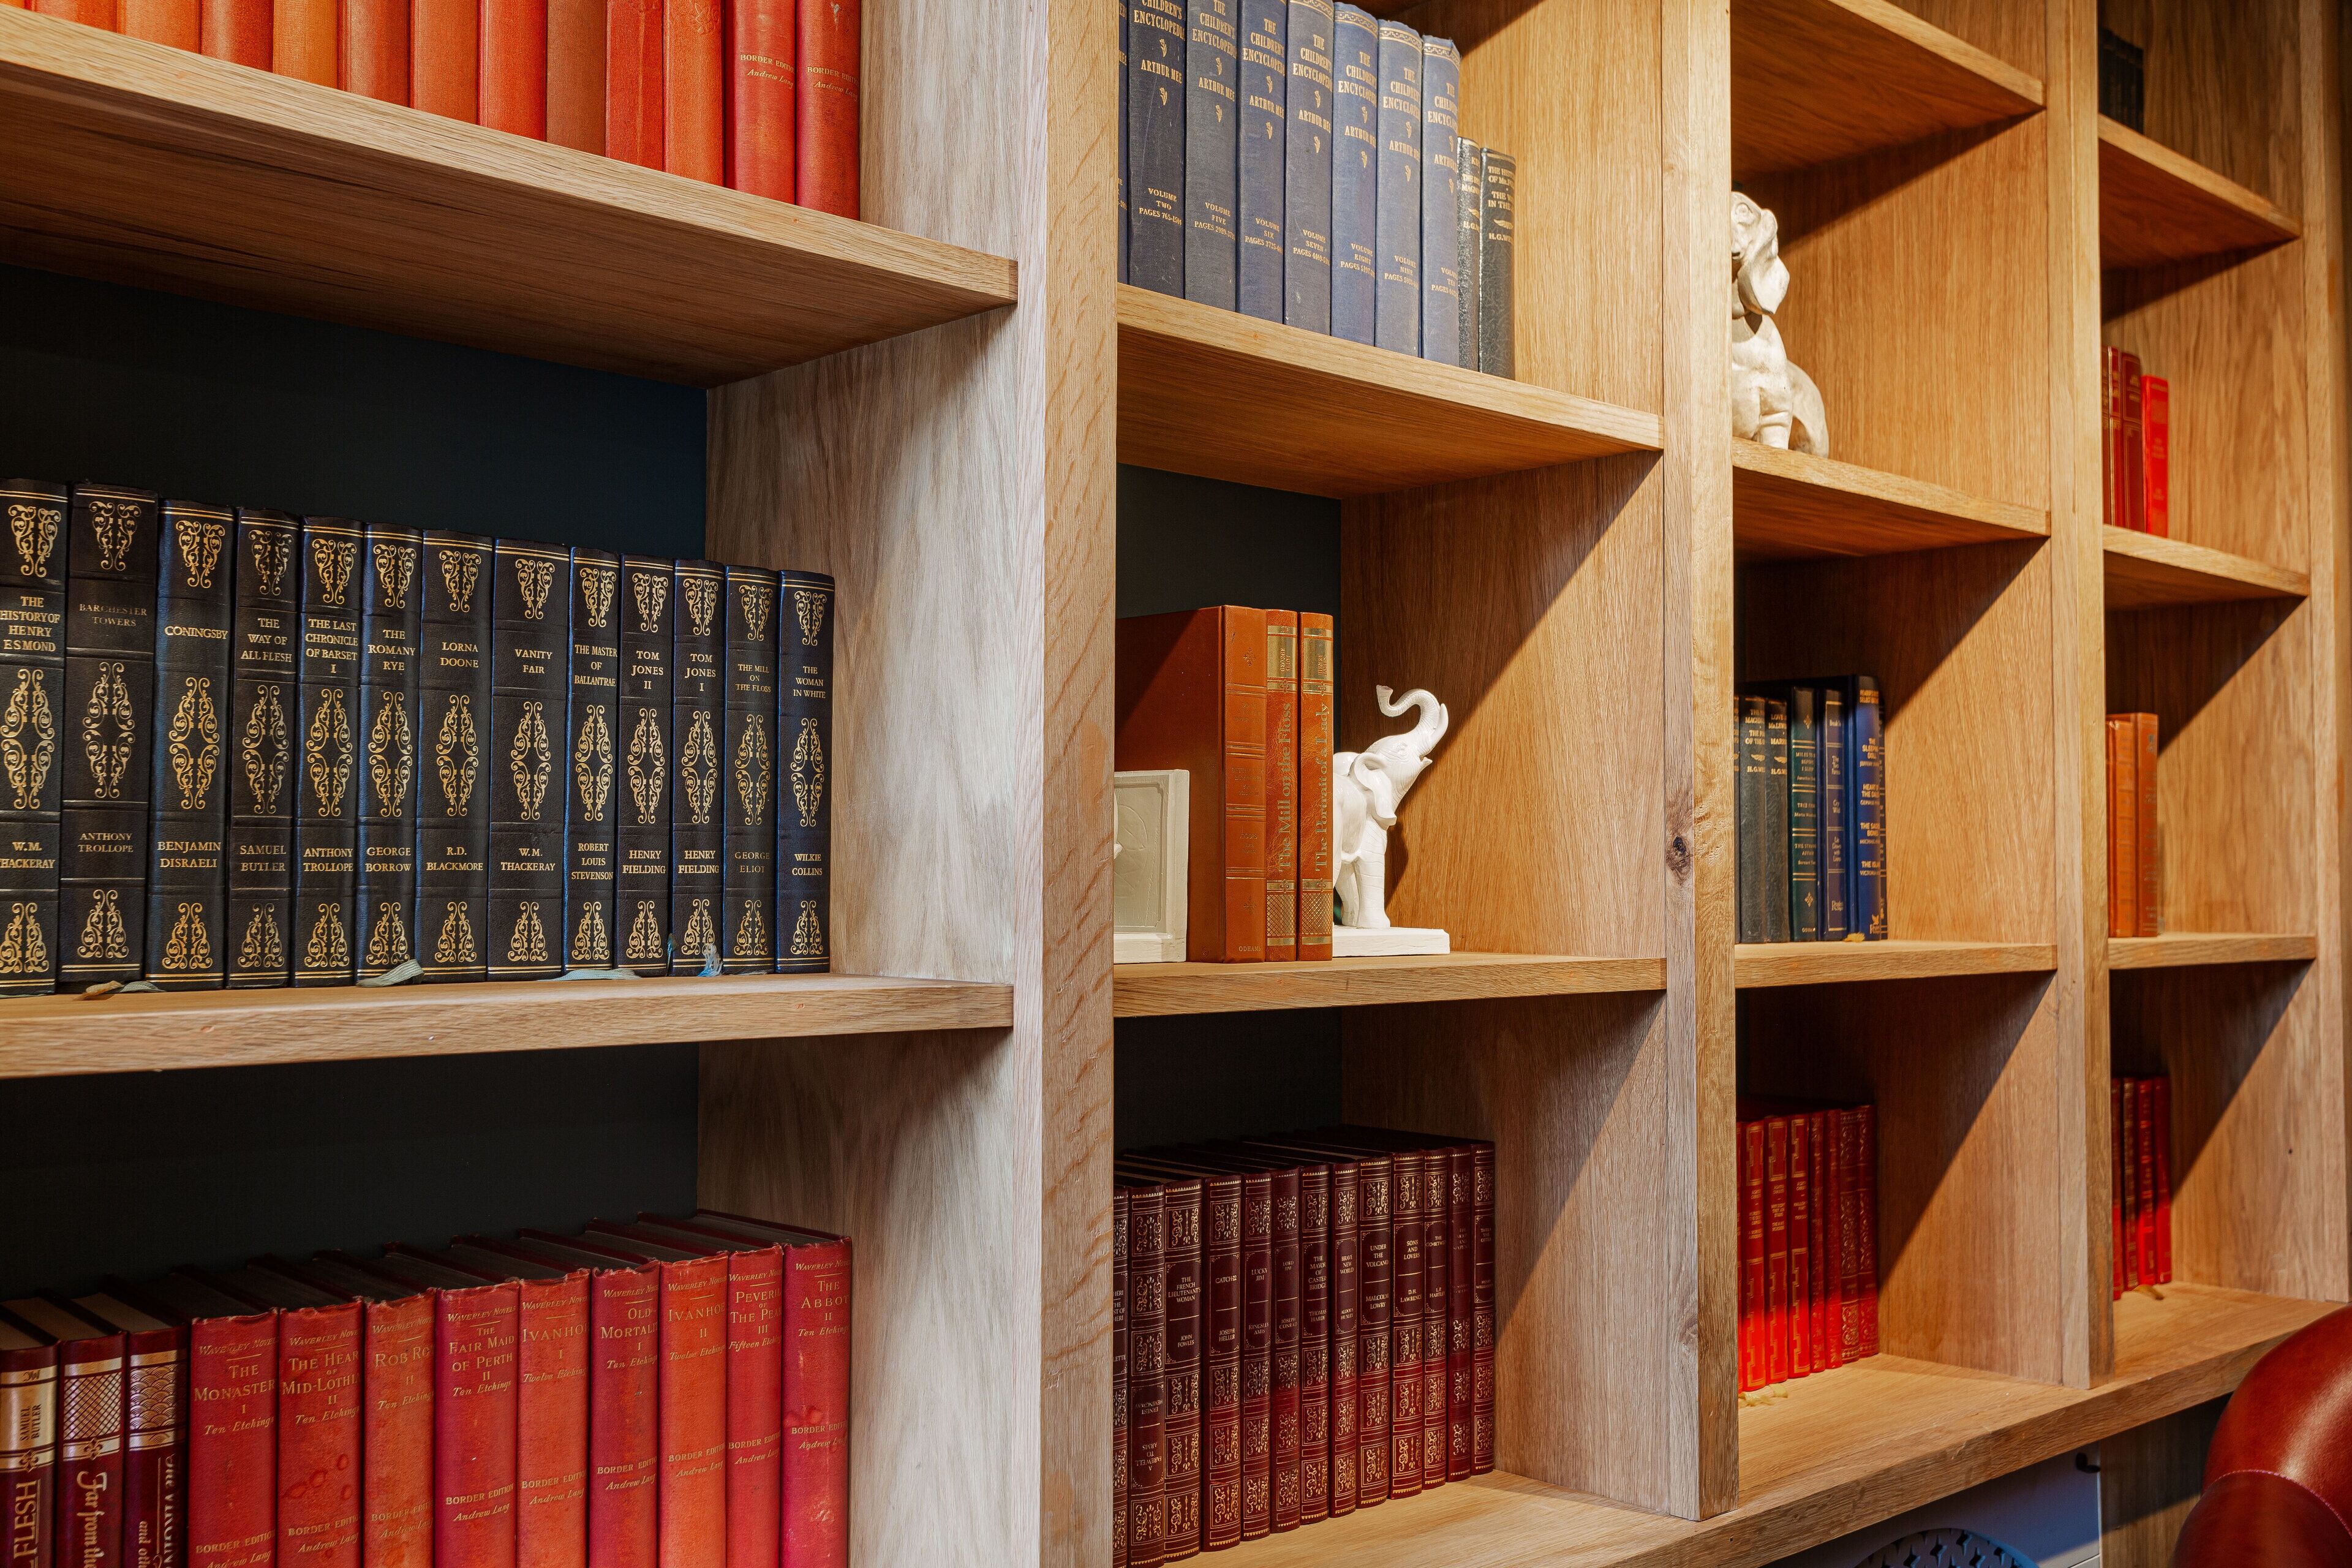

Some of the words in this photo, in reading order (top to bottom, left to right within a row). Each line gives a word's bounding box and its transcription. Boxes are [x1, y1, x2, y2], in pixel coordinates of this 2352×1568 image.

[1213, 0, 1226, 16] THE
[1200, 13, 1235, 40] CHILDREN'S
[1264, 18, 1276, 35] THE
[1313, 34, 1325, 51] THE
[741, 55, 772, 64] BORDER
[807, 67, 839, 77] BORDER
[1141, 59, 1169, 78] ARTHUR
[1171, 66, 1182, 84] MEE
[747, 69, 777, 80] Andrew
[779, 76, 793, 88] Lang
[1199, 77, 1224, 96] ARTHUR
[1226, 84, 1235, 102] MEE
[1148, 187, 1177, 202] VOLUME
[1156, 200, 1172, 210] TWO
[1139, 208, 1160, 217] PAGES
[1212, 214, 1226, 225] FIVE
[1256, 217, 1280, 233] VOLUME
[1264, 229, 1274, 239] SIX
[1306, 240, 1324, 252] SEVEN
[1354, 254, 1371, 265] EIGHT
[20, 596, 44, 608] THE
[79, 603, 147, 616] BARCHESTER
[0, 611, 47, 622] HISTORY
[47, 614, 61, 624] OF
[92, 617, 136, 627] TOWERS
[257, 617, 279, 628] THE
[9, 625, 52, 637] HENRY
[308, 619, 331, 628] THE
[333, 621, 356, 631] LAST
[164, 626, 228, 639] CONINGSBY
[247, 634, 271, 644] WAY
[274, 636, 287, 645] OF
[305, 633, 358, 646] CHRONICLE
[4, 640, 56, 652] ESMOND
[368, 644, 416, 657] ROMANY
[442, 642, 478, 652] LORNA
[575, 644, 589, 654] THE
[592, 646, 617, 657] MASTER
[241, 650, 261, 660] ALL
[262, 652, 292, 662] FLESH
[306, 648, 320, 658] OF
[321, 649, 357, 661] BARSET
[514, 649, 552, 660] VANITY
[636, 650, 660, 660] TOM
[383, 662, 405, 671] RYE
[440, 657, 479, 668] DOONE
[590, 661, 602, 671] OF
[522, 665, 545, 674] FAIR
[631, 665, 664, 676] JONES
[755, 665, 769, 674] MILL
[574, 674, 616, 687] BALLANTRAE
[796, 677, 824, 687] WOMAN
[752, 685, 771, 693] FLOSS
[804, 690, 826, 699] WHITE
[1276, 703, 1291, 745] Floss
[1315, 703, 1330, 744] Lady
[1277, 749, 1291, 774] the
[1315, 756, 1327, 775] of
[1281, 776, 1291, 797] on
[1315, 777, 1328, 833] Portrait
[1277, 800, 1291, 834] Mill
[80, 832, 133, 841] ANTHONY
[12, 842, 42, 851] W.M.
[78, 844, 134, 853] TROLLOPE
[157, 841, 221, 853] BENJAMIN
[239, 845, 287, 854] SAMUEL
[366, 847, 411, 856] GEORGE
[578, 843, 609, 851] ROBERT
[684, 850, 715, 859] HENRY
[794, 853, 821, 862] WILKIE
[1277, 843, 1291, 872] The
[1315, 838, 1328, 871] The
[0, 858, 55, 869] HACKERAY
[160, 858, 217, 868] DISRAELI
[241, 862, 285, 872] BUTLER
[365, 863, 412, 872] BORROW
[426, 862, 483, 871] BLACKMORE
[501, 862, 556, 871] THACKERAY
[622, 865, 666, 874] FIELDING
[792, 867, 823, 876] COLLINS
[571, 872, 613, 880] STEVENSON
[1215, 1275, 1237, 1284] CATCH-22
[801, 1295, 848, 1308] ABBOT
[1365, 1293, 1389, 1302] MALCOLM
[1400, 1294, 1422, 1303] LAWRENCE
[448, 1311, 490, 1322] WAVERLEY
[493, 1305, 515, 1316] NOVELS
[628, 1308, 652, 1320] OLD
[668, 1302, 725, 1322] IVANHOE
[477, 1327, 495, 1336] THE
[289, 1334, 337, 1346] WAVERLEY
[449, 1341, 481, 1354] FAIR
[488, 1335, 514, 1348] MAID
[1178, 1339, 1194, 1348] FOWLES
[729, 1341, 759, 1352] Fifteen
[374, 1352, 407, 1368] ROB
[452, 1361, 469, 1372] OF
[477, 1352, 512, 1369] PERTH
[229, 1365, 258, 1379] THE
[524, 1373, 553, 1383] Twelve
[478, 1380, 511, 1393] Etchings
[20, 1406, 31, 1441] SAMUEL
[32, 1404, 41, 1439] BUTLER
[295, 1414, 315, 1425] Ten
[205, 1425, 225, 1435] Ten
[77, 1471, 107, 1509] Far
[446, 1493, 484, 1505] BORDER
[488, 1483, 514, 1498] EDITION
[453, 1510, 489, 1522] Andrew
[492, 1503, 510, 1514] Lang
[13, 1480, 37, 1559] FLESH
